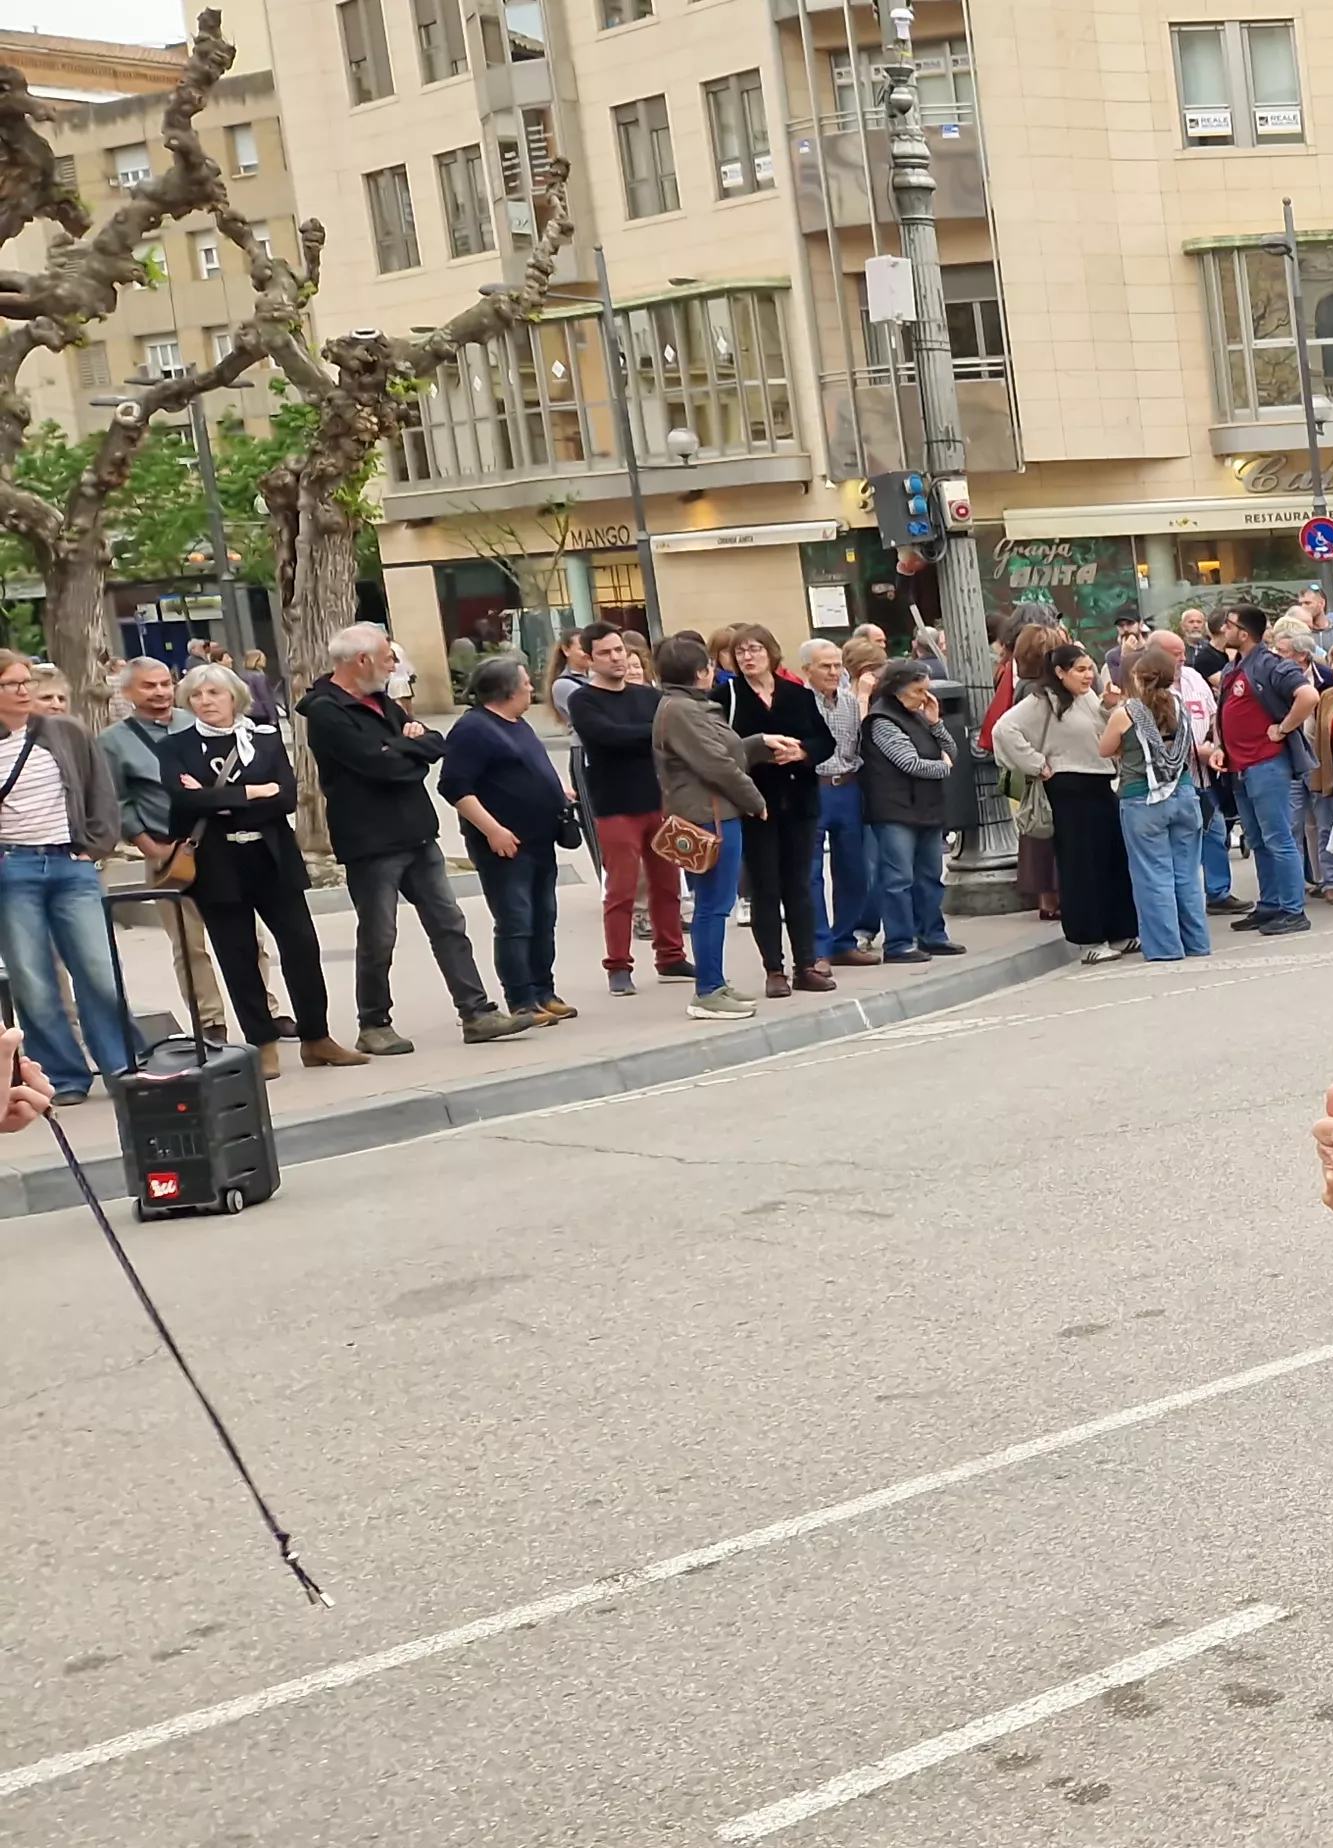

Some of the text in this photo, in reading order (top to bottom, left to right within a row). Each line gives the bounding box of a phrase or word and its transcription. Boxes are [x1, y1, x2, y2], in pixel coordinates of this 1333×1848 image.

[571, 524, 631, 548] MANGO
[993, 537, 1072, 580] Granja
[1009, 562, 1098, 588] ANITA
